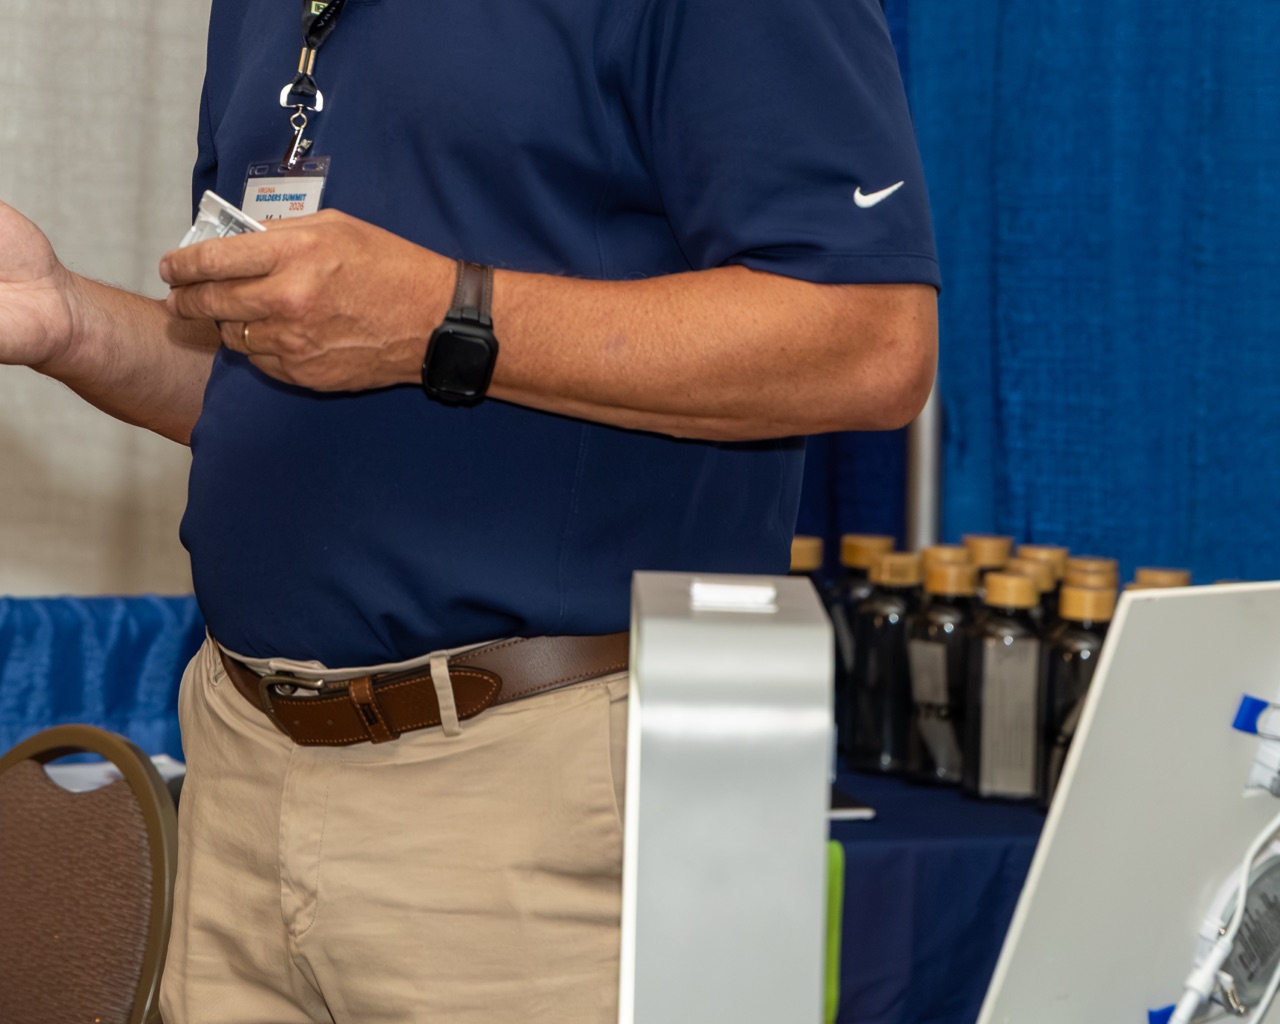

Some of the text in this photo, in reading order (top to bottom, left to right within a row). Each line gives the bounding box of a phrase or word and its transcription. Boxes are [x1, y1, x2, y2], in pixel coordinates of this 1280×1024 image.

[255, 193, 307, 202] BUILDERS SUMMIT
[289, 202, 305, 211] 2026
